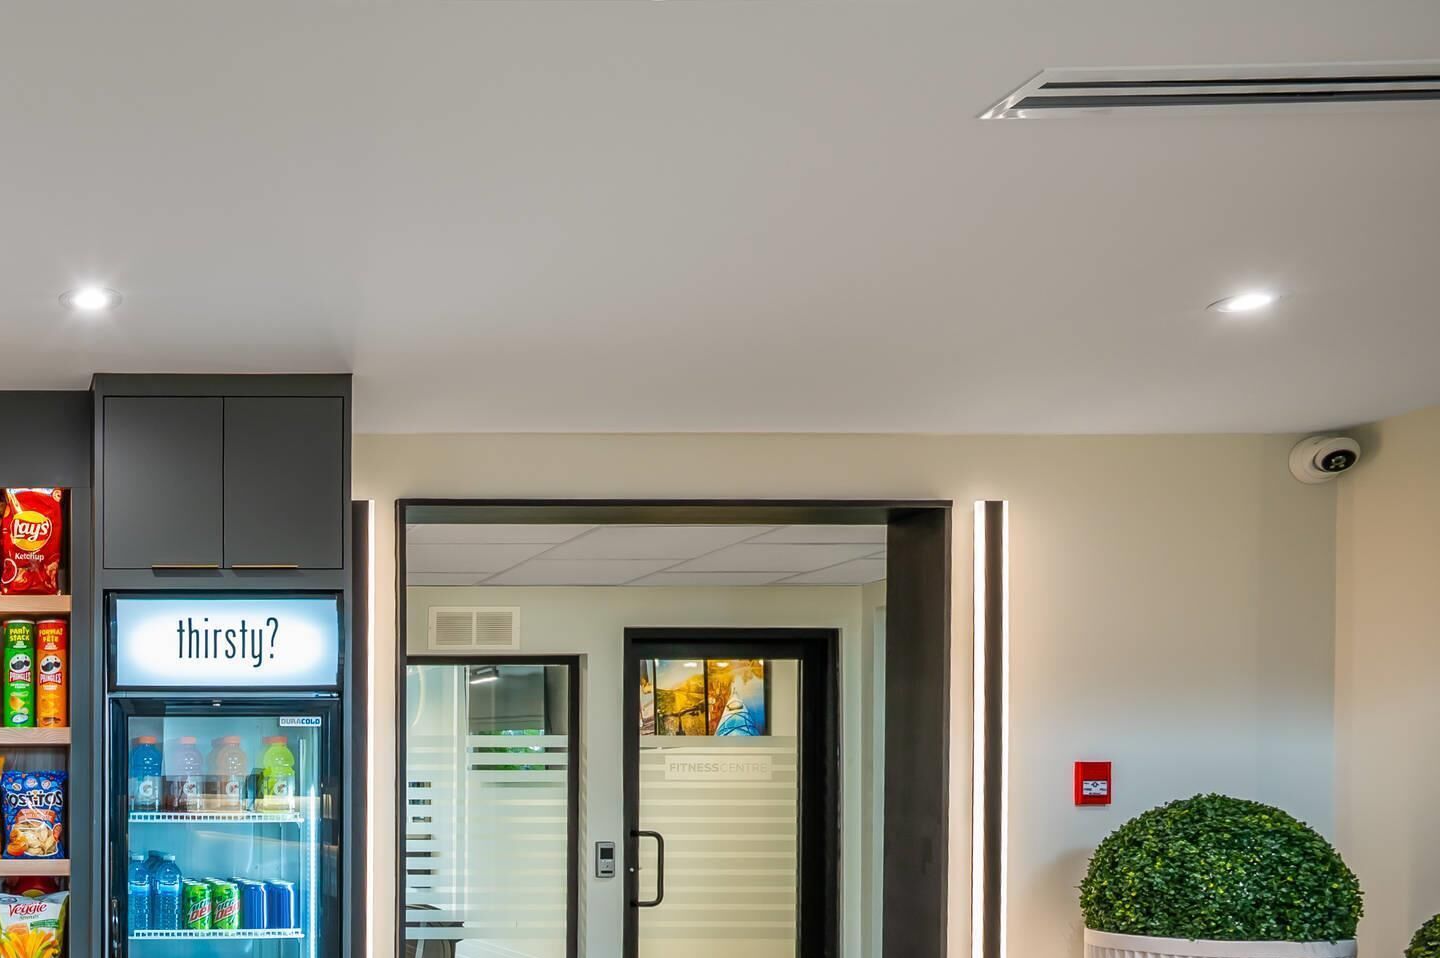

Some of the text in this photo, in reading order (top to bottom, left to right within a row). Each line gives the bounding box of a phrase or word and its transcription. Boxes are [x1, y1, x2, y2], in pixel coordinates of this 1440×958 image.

[13, 518, 50, 542] Lay's
[14, 552, 45, 561] Ketchup
[177, 617, 279, 668] thirsty?
[9, 901, 48, 917] Veggie
